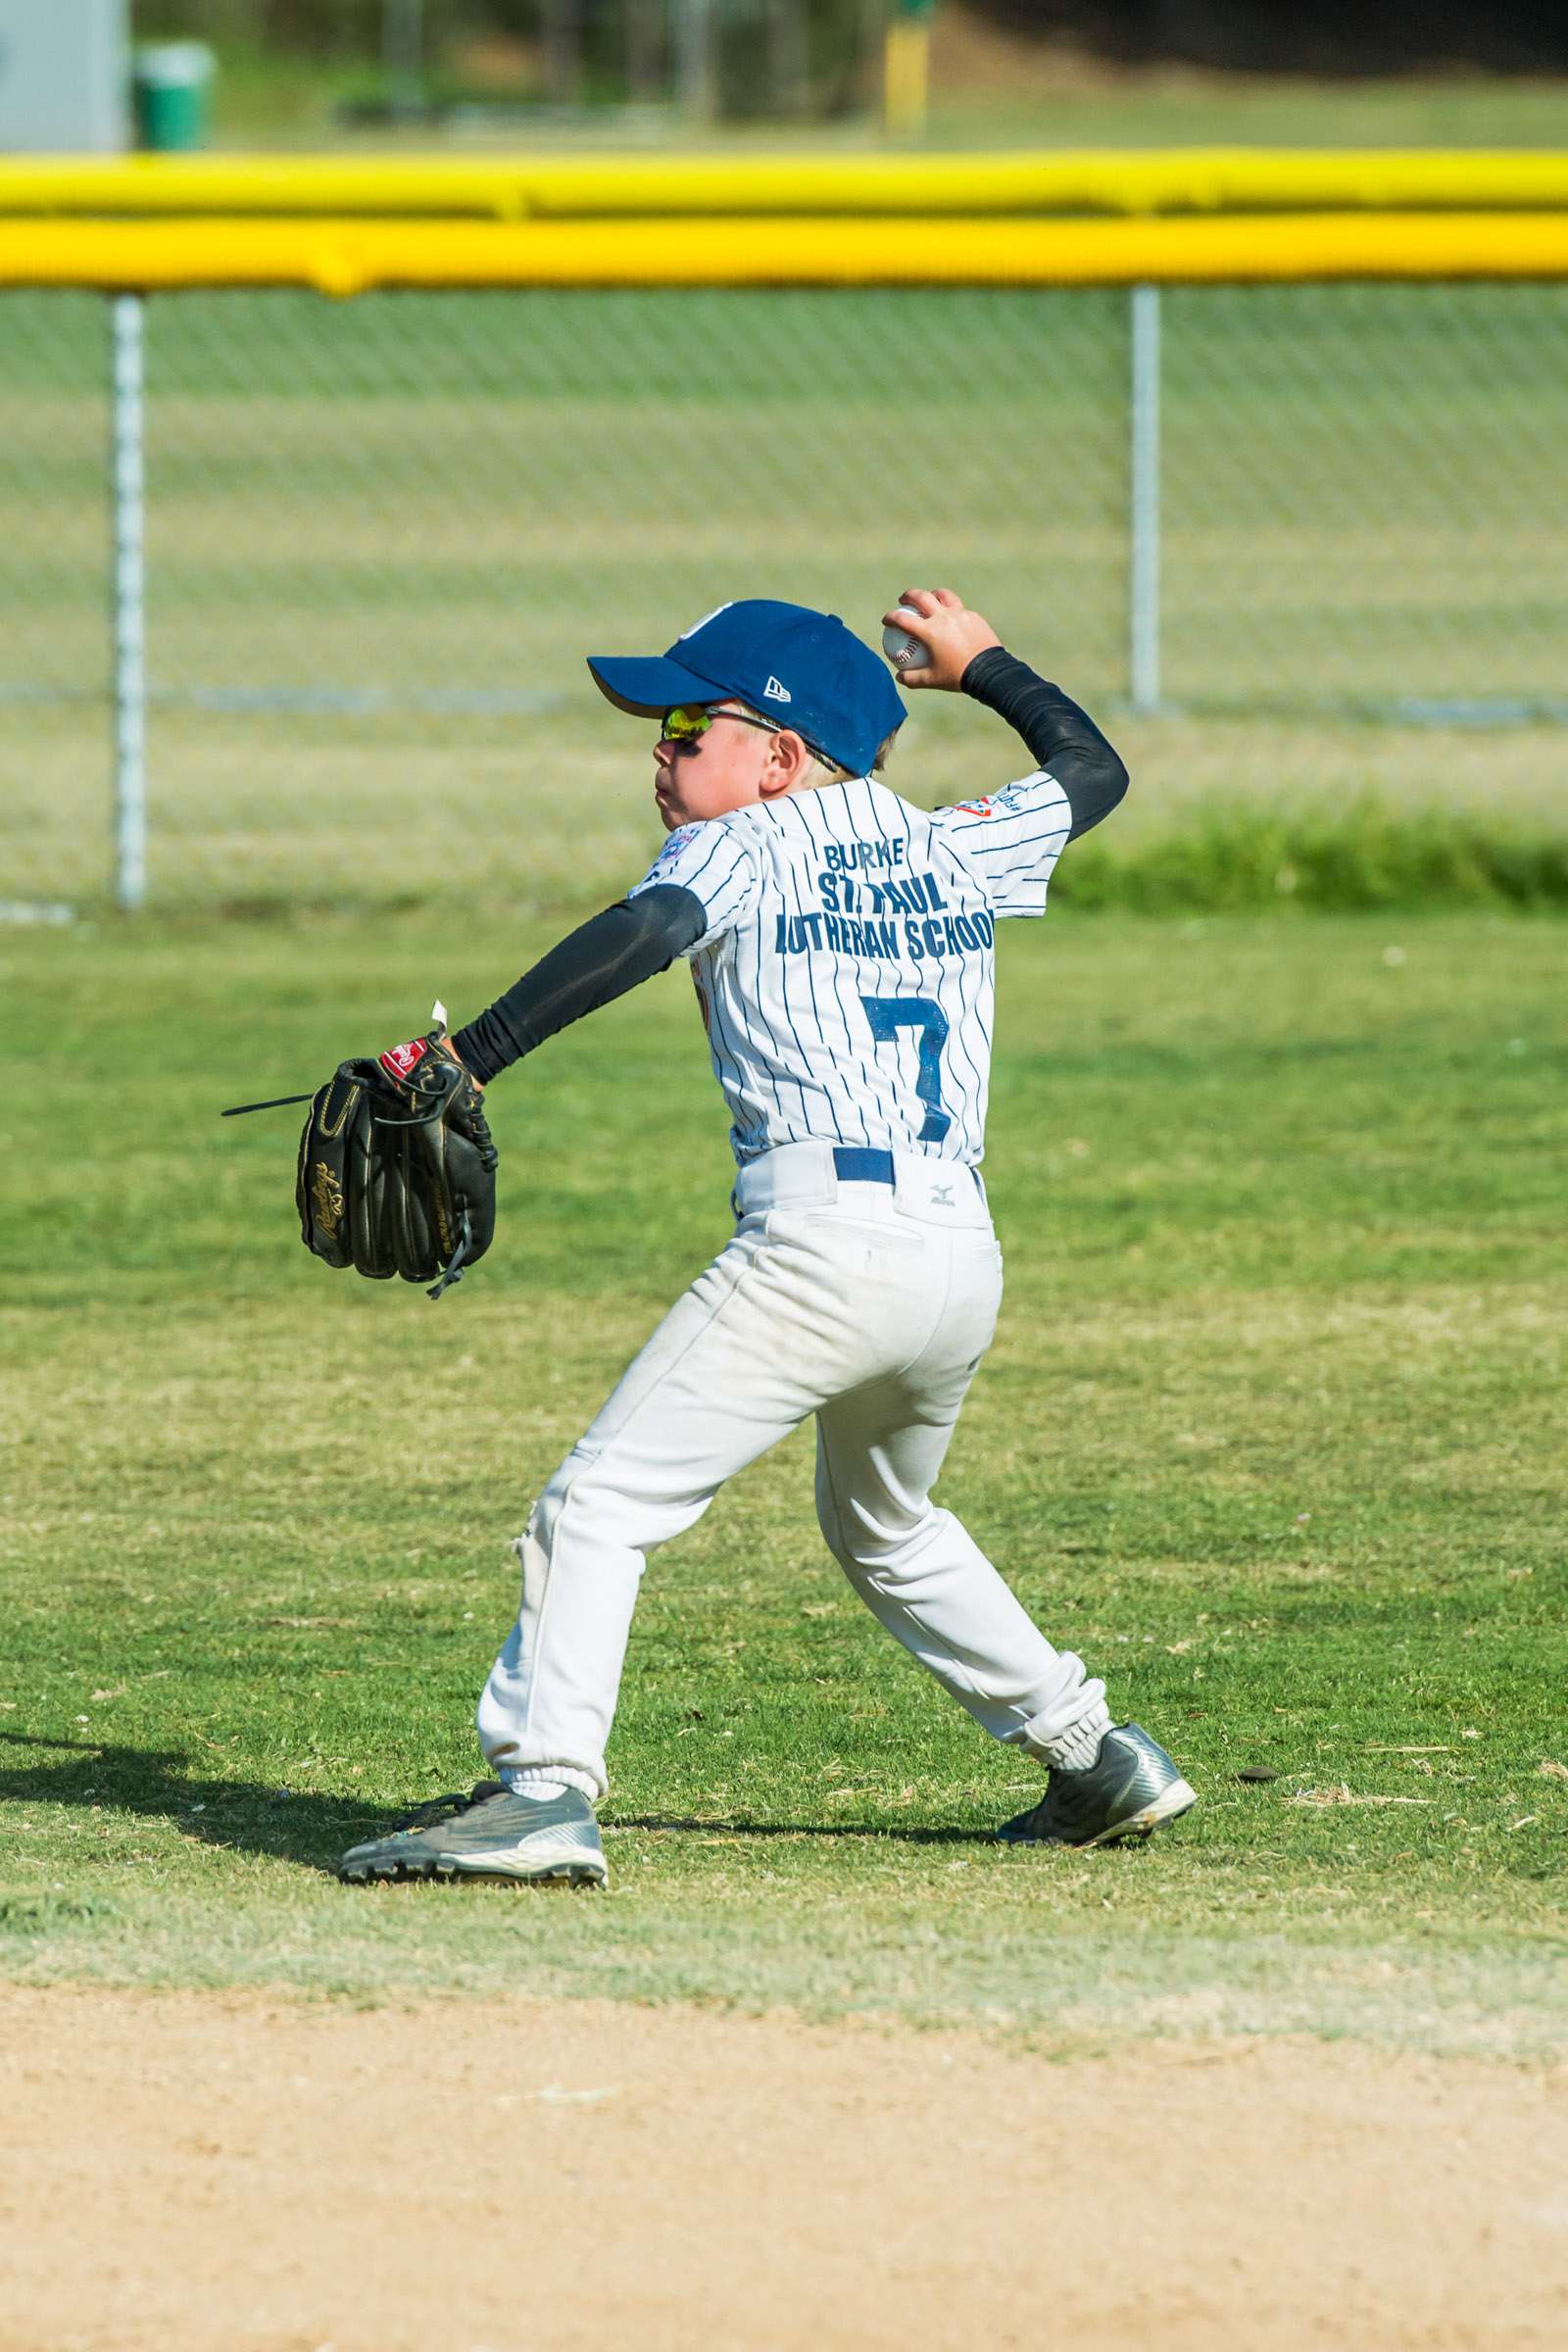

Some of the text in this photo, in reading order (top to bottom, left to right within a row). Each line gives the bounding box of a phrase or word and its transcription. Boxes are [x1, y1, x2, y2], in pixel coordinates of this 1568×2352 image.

[823, 838, 904, 871] BURKE
[818, 872, 862, 913] ST.
[775, 912, 900, 959] LUTHERAN
[859, 997, 951, 1142] 7
